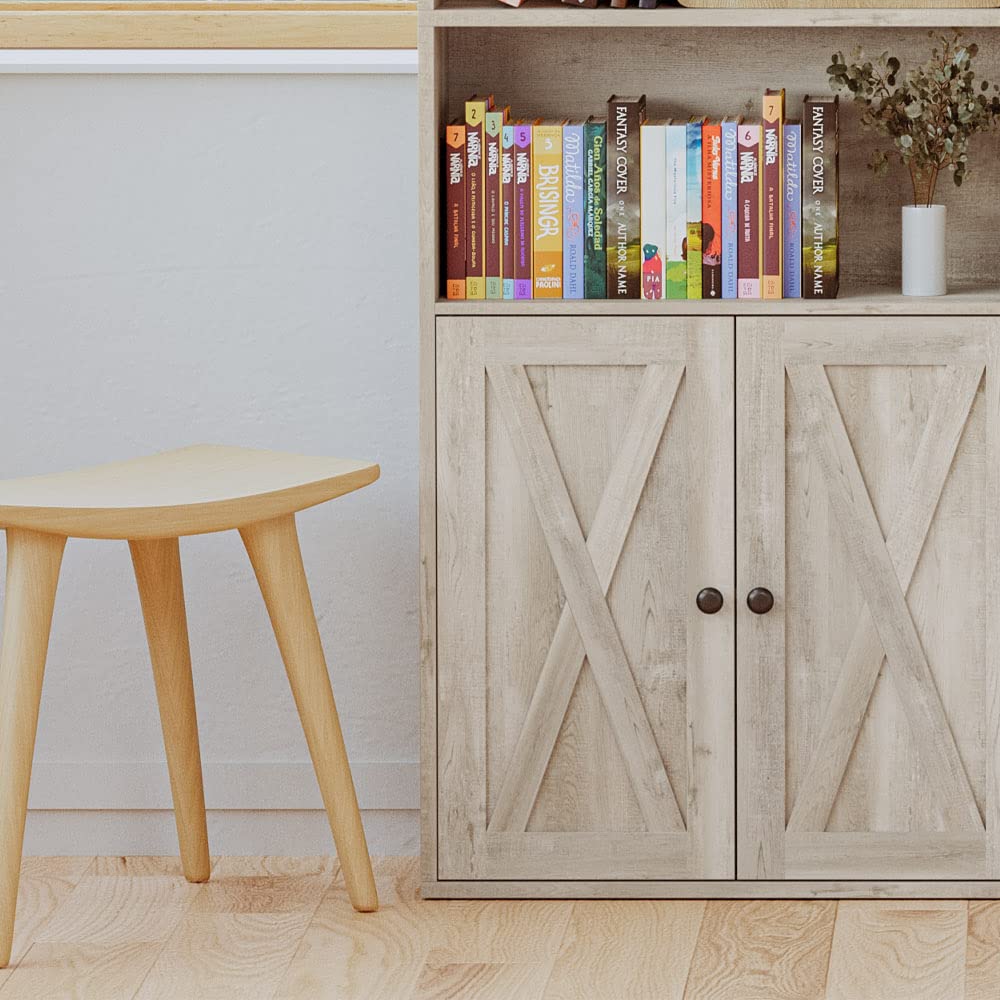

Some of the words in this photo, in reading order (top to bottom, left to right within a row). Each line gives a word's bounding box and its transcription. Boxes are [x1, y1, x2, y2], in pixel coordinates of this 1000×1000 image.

[471, 109, 477, 119] 2
[491, 120, 496, 130] 3
[616, 106, 627, 153] FANTASY
[769, 106, 774, 116] 7
[812, 106, 823, 153] FANTASY
[520, 132, 526, 142] 5
[744, 130, 752, 140] 6
[564, 132, 581, 202] Matilda
[594, 164, 602, 194] Años
[616, 156, 627, 195] COVER
[724, 128, 736, 200] Matilda
[786, 131, 799, 202] Matilda
[812, 156, 823, 195] COVER
[536, 164, 560, 240] BRISINGR
[594, 207, 602, 250] Soledad
[617, 222, 627, 262] AUTHOR
[813, 222, 823, 262] AUTHOR
[617, 265, 627, 294] NAME
[813, 265, 823, 294] NAME
